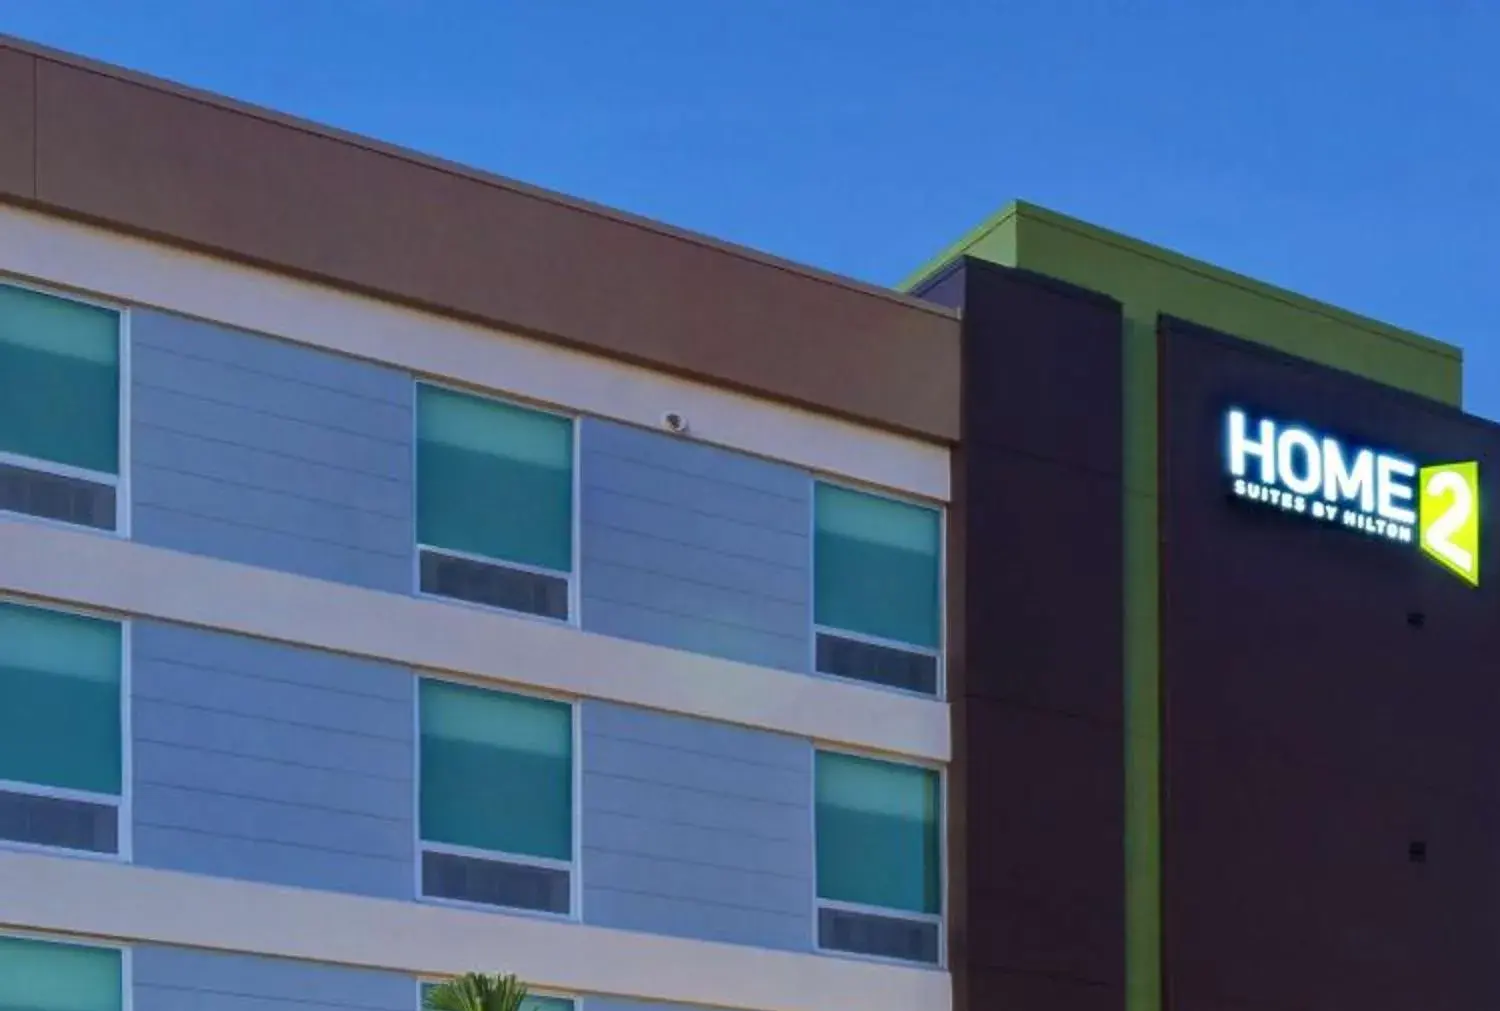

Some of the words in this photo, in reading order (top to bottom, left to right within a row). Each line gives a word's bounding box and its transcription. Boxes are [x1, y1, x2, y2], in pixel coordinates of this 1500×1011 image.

[1228, 409, 1416, 524] HOME
[1426, 471, 1473, 573] 2
[1234, 479, 1305, 512] SUITES
[1312, 501, 1337, 520] BY
[1343, 510, 1411, 542] HILTON
